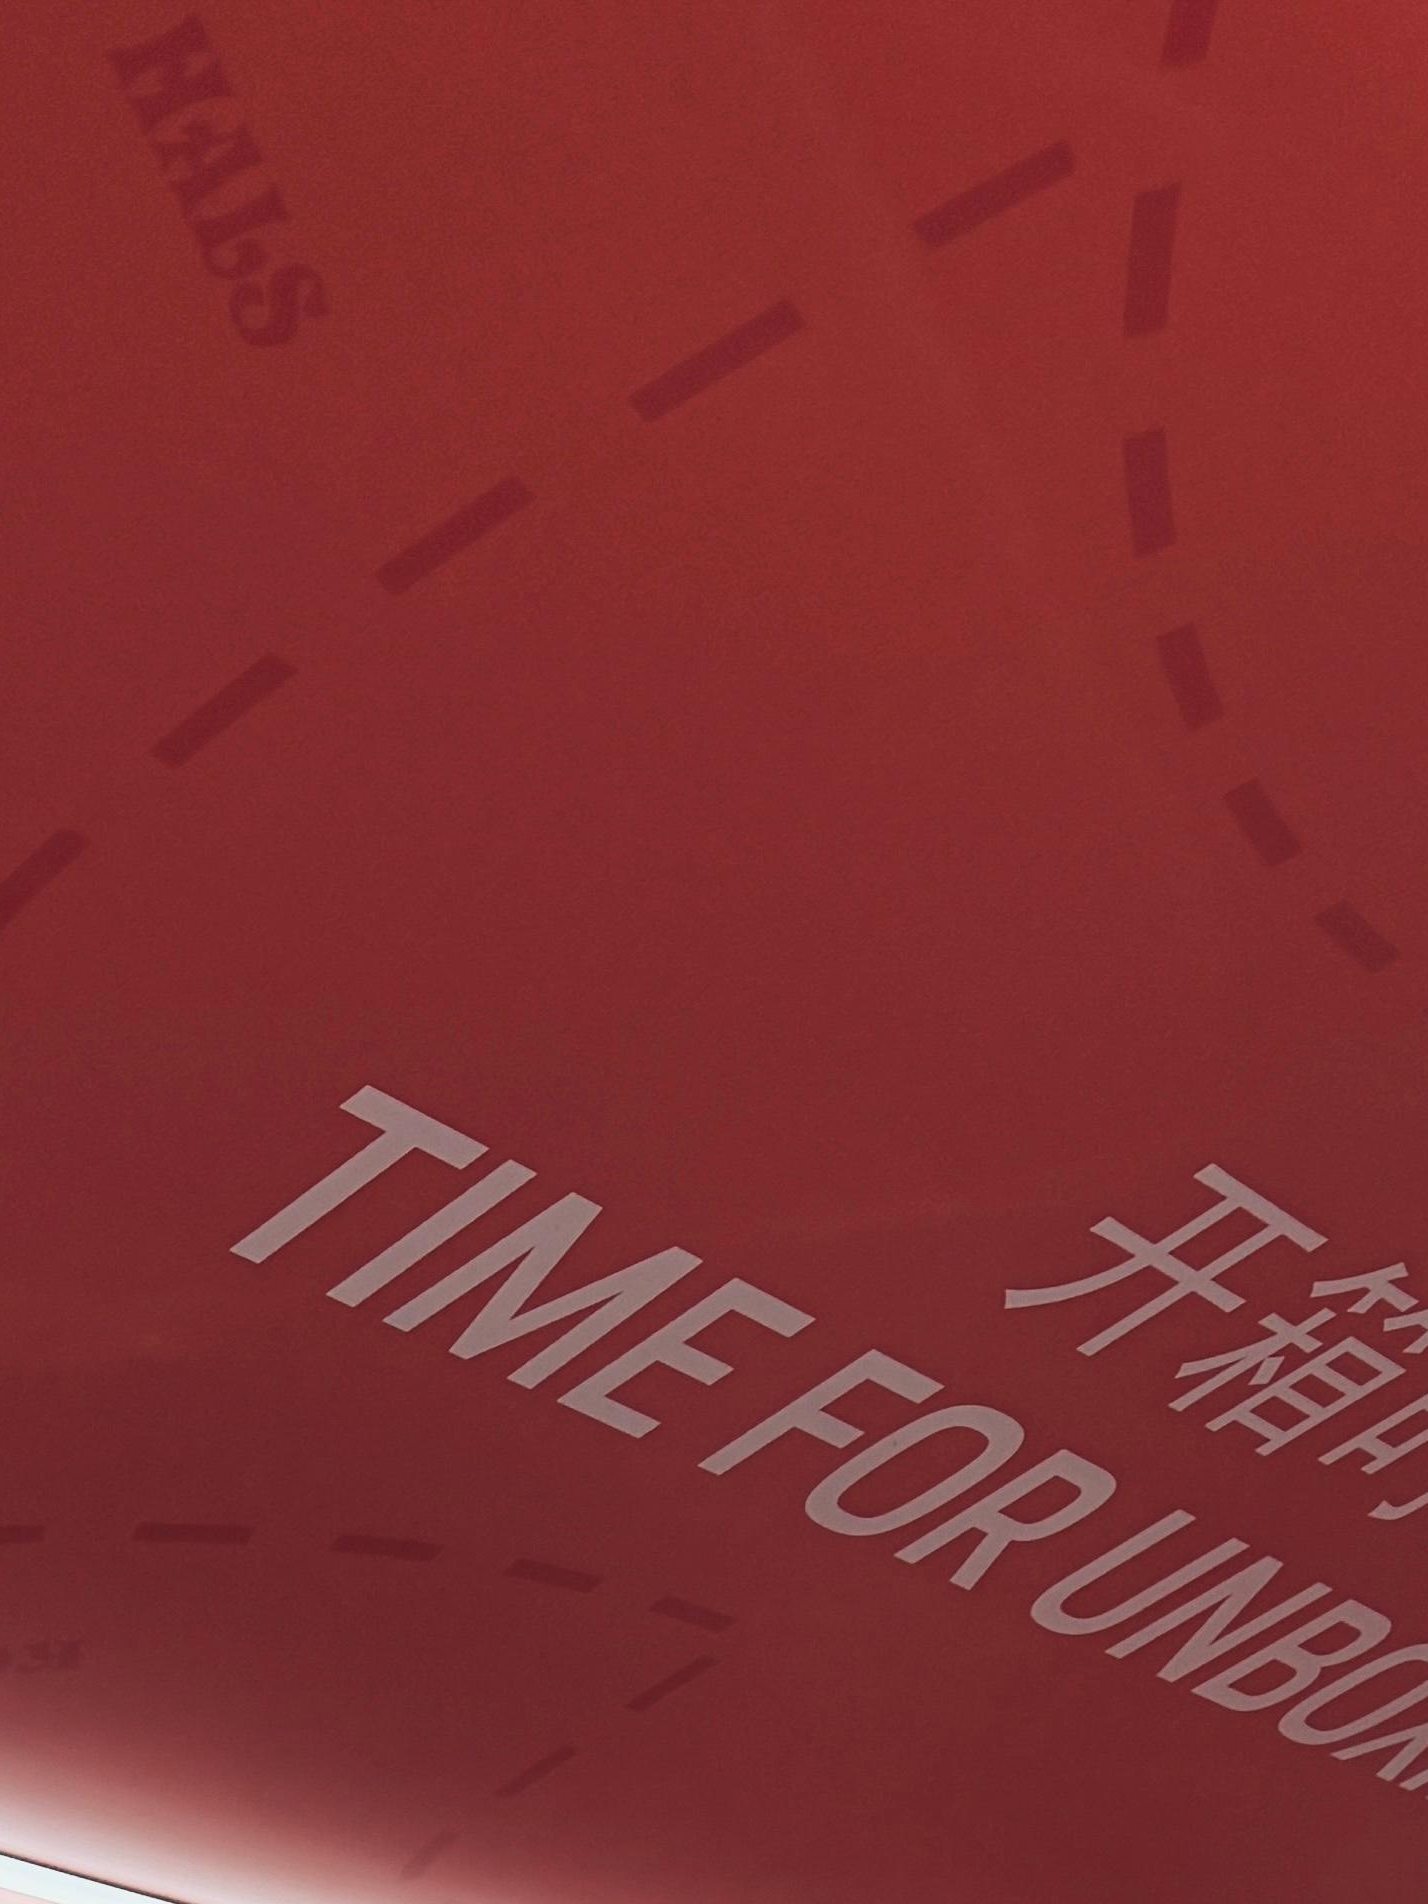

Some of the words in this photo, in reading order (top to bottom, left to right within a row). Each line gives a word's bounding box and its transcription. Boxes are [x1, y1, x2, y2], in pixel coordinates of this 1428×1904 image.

[106, 13, 333, 347] HALS
[229, 1085, 816, 1438] TIME
[697, 1347, 1117, 1590] FOR
